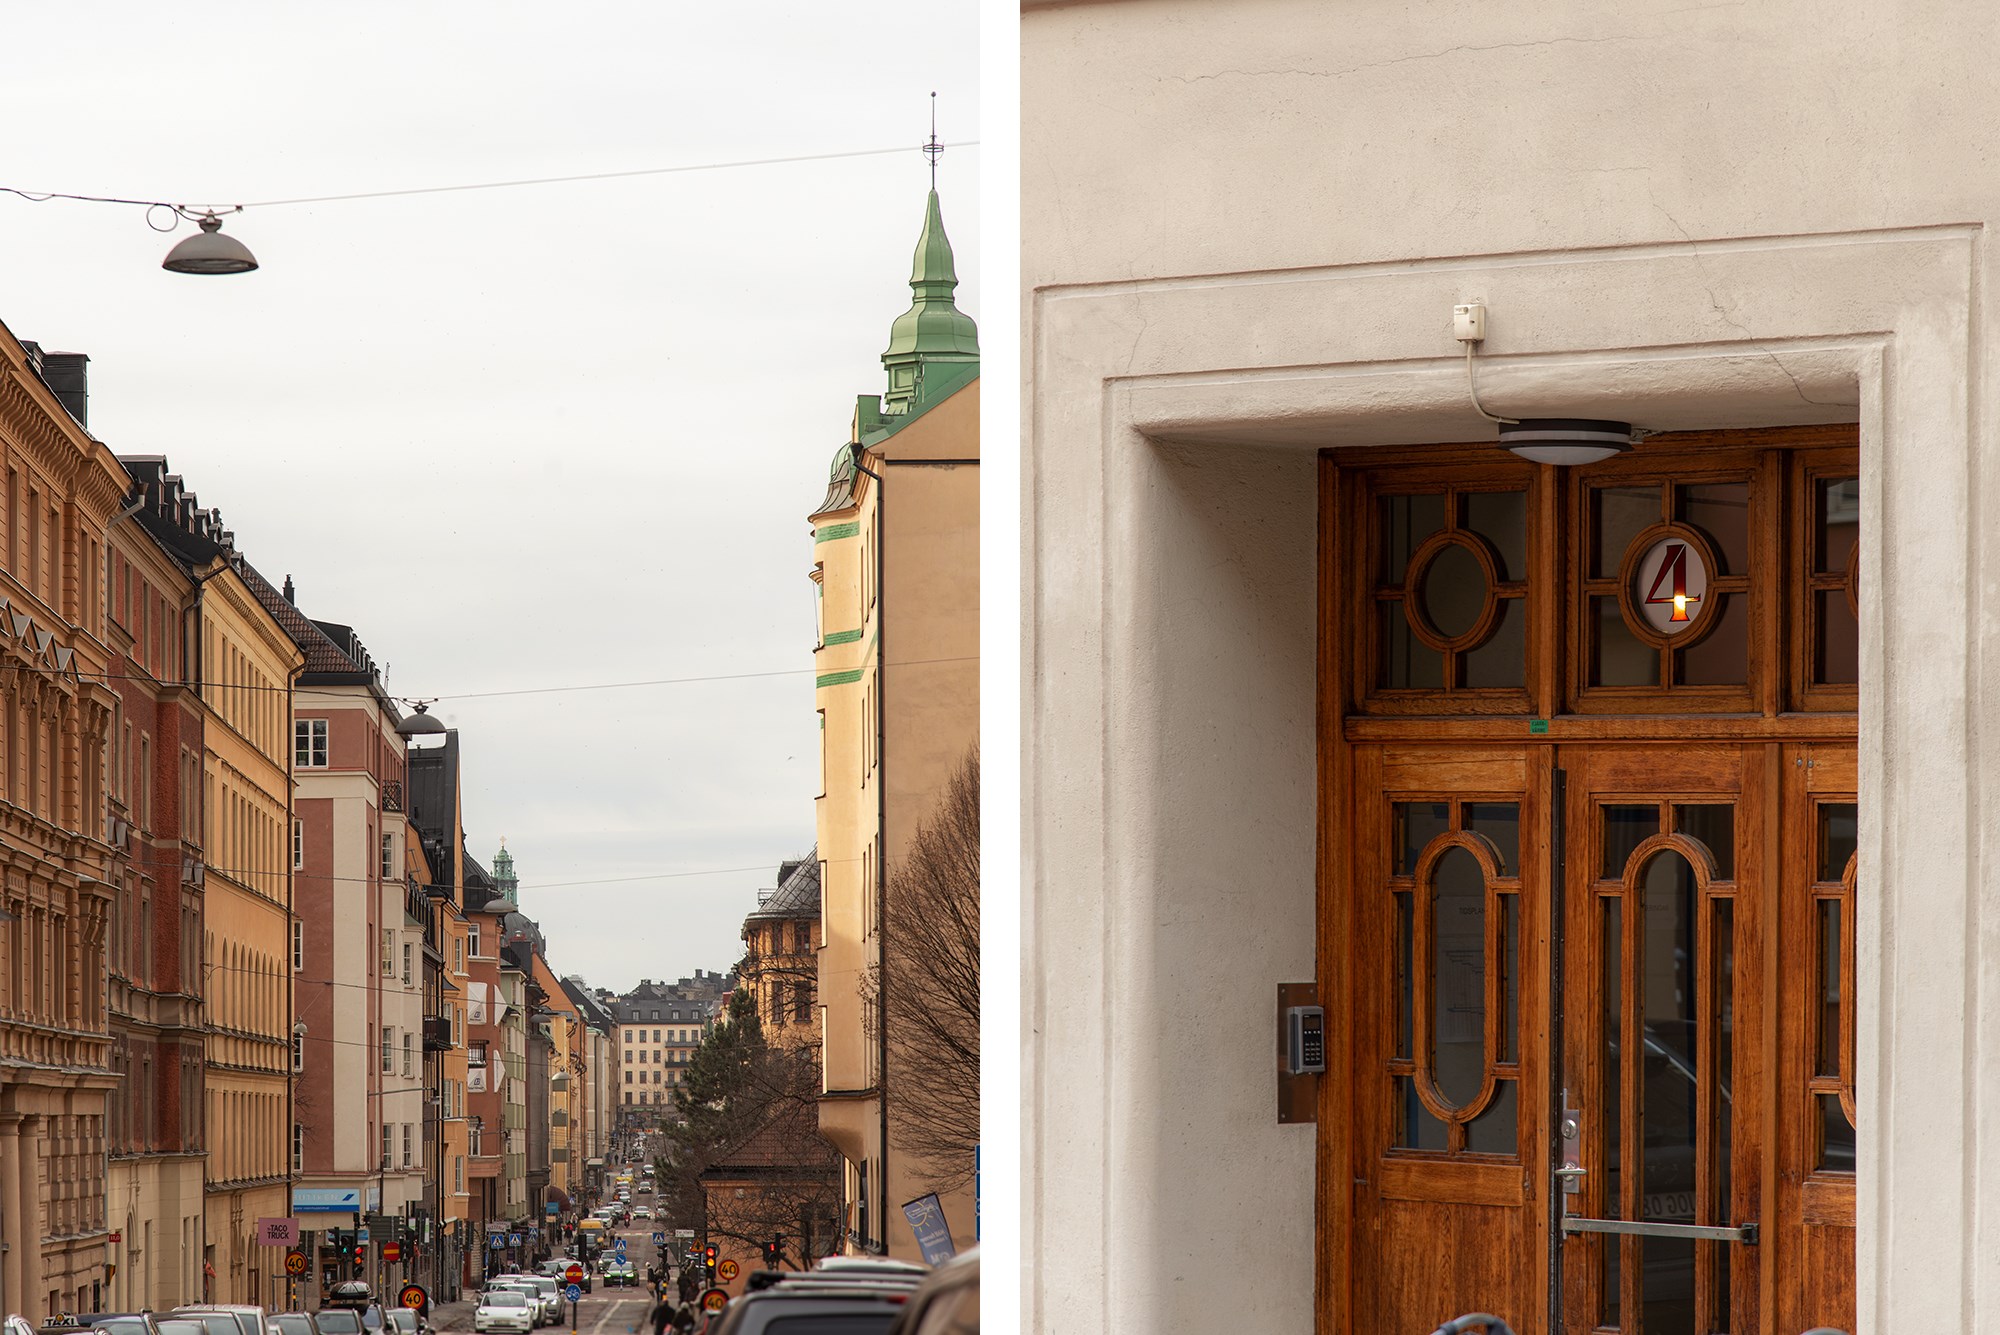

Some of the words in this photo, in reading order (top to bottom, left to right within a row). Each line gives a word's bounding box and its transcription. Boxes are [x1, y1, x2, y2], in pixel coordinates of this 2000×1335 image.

[1645, 544, 1701, 622] 4
[288, 1257, 303, 1269] 40
[722, 1264, 736, 1275] 40
[406, 1294, 420, 1304] 40
[708, 1297, 723, 1309] 40
[45, 1317, 75, 1326] TAXI
